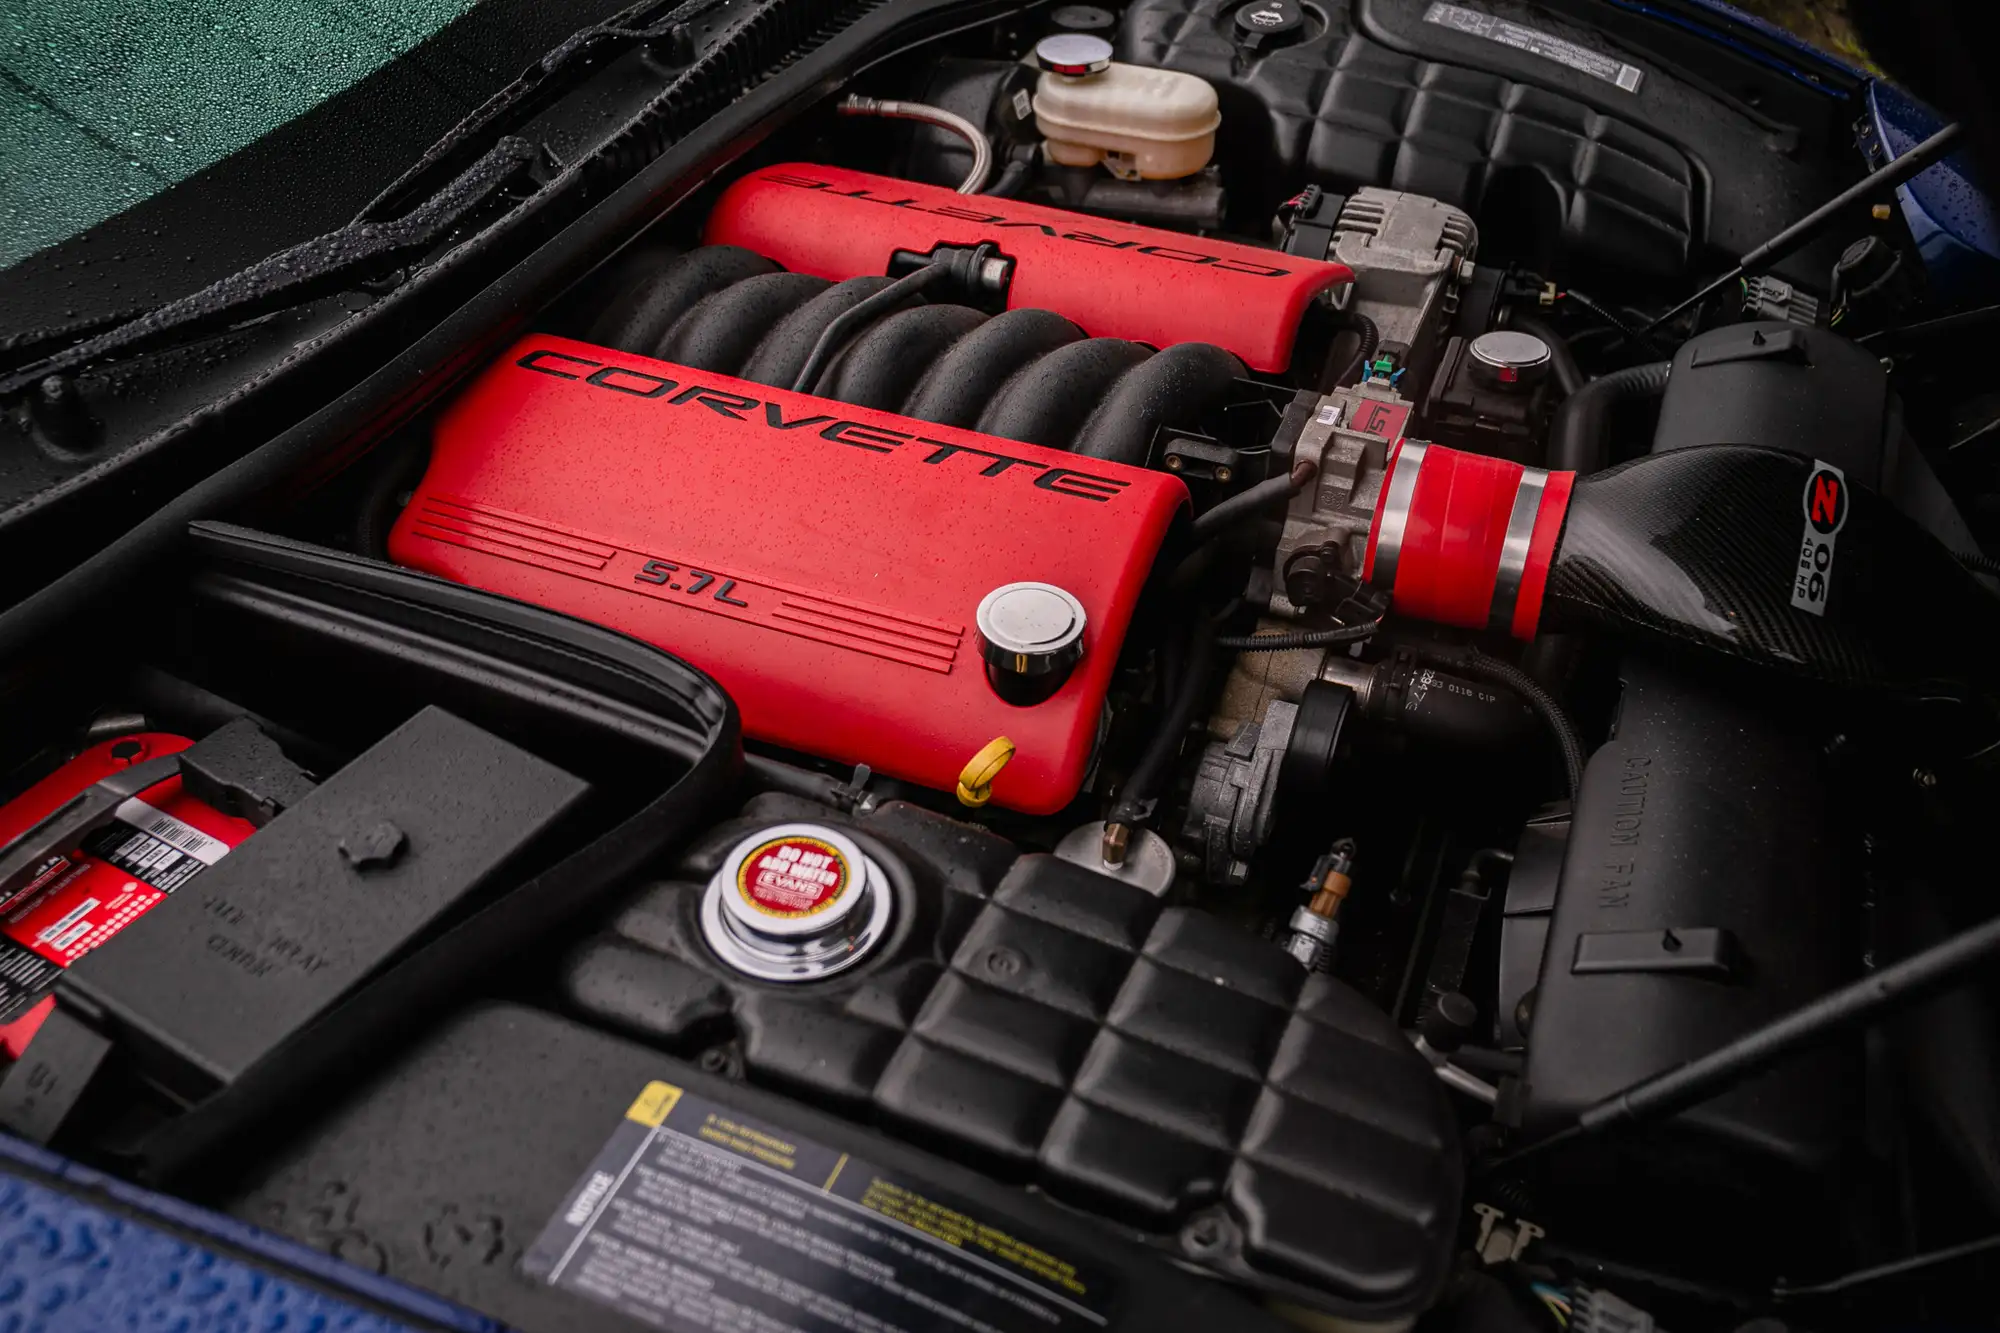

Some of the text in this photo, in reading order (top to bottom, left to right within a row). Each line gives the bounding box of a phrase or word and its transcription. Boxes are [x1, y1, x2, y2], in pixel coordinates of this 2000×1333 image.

[758, 174, 1293, 278] CORVETTE
[515, 349, 1132, 502] CORVETTE
[634, 559, 749, 608] 5.7L
[1797, 574, 1808, 599] HP
[1598, 757, 1652, 909] CAUTION FAN
[758, 855, 838, 887] ADD WATER
[777, 845, 834, 869] DO NOT
[762, 870, 820, 895] EVANS
